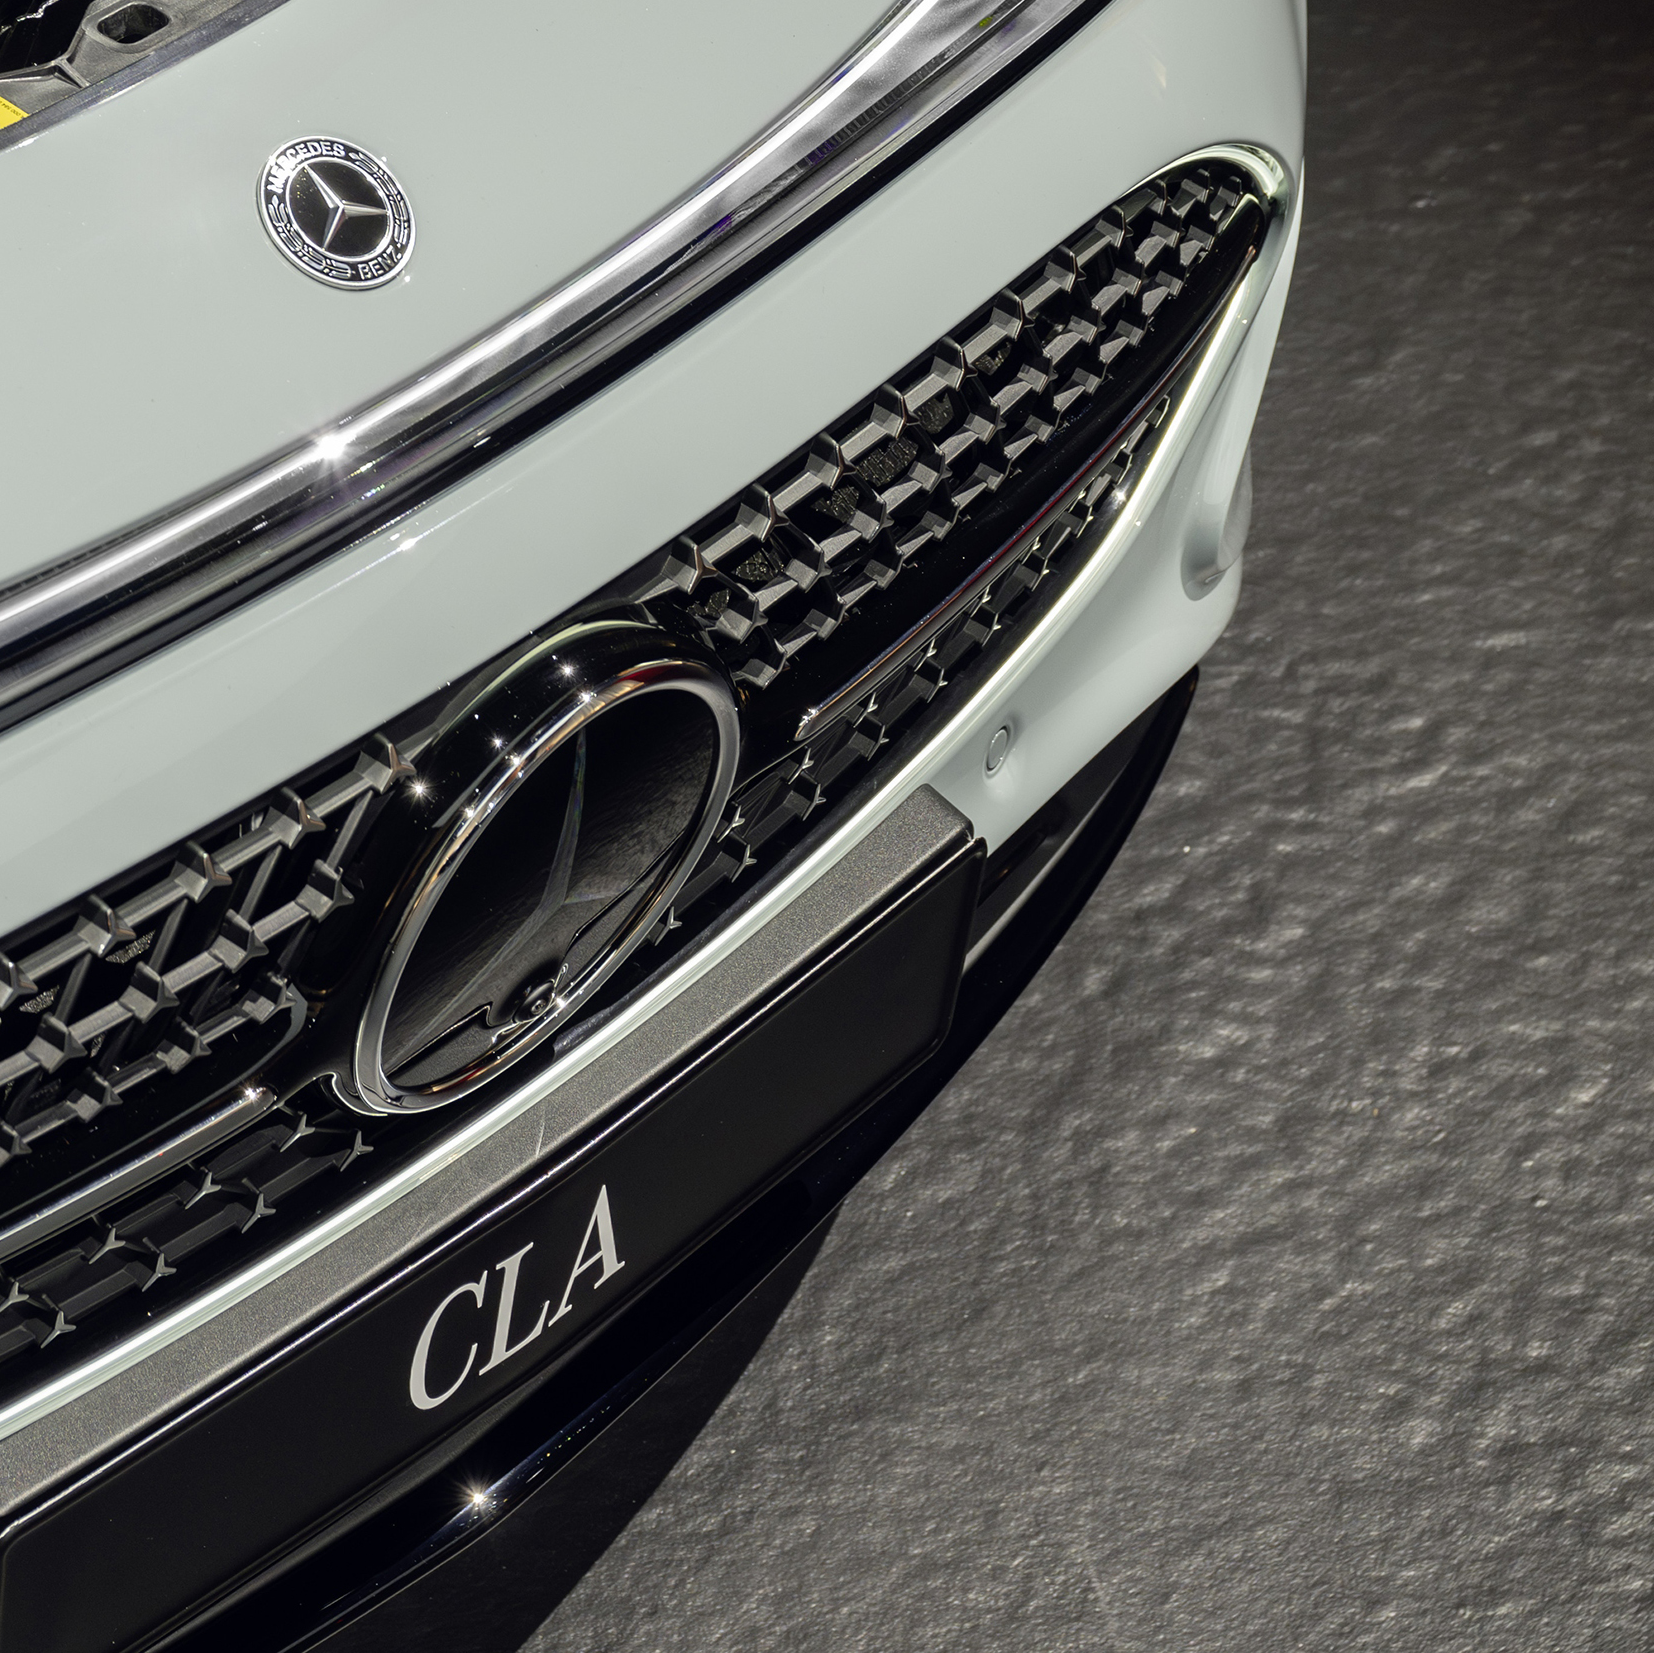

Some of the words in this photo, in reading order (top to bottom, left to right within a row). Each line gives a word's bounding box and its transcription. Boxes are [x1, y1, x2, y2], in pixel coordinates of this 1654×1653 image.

[267, 141, 346, 194] MERCEDES
[357, 245, 402, 280] BENZ
[409, 1184, 626, 1411] CLA
